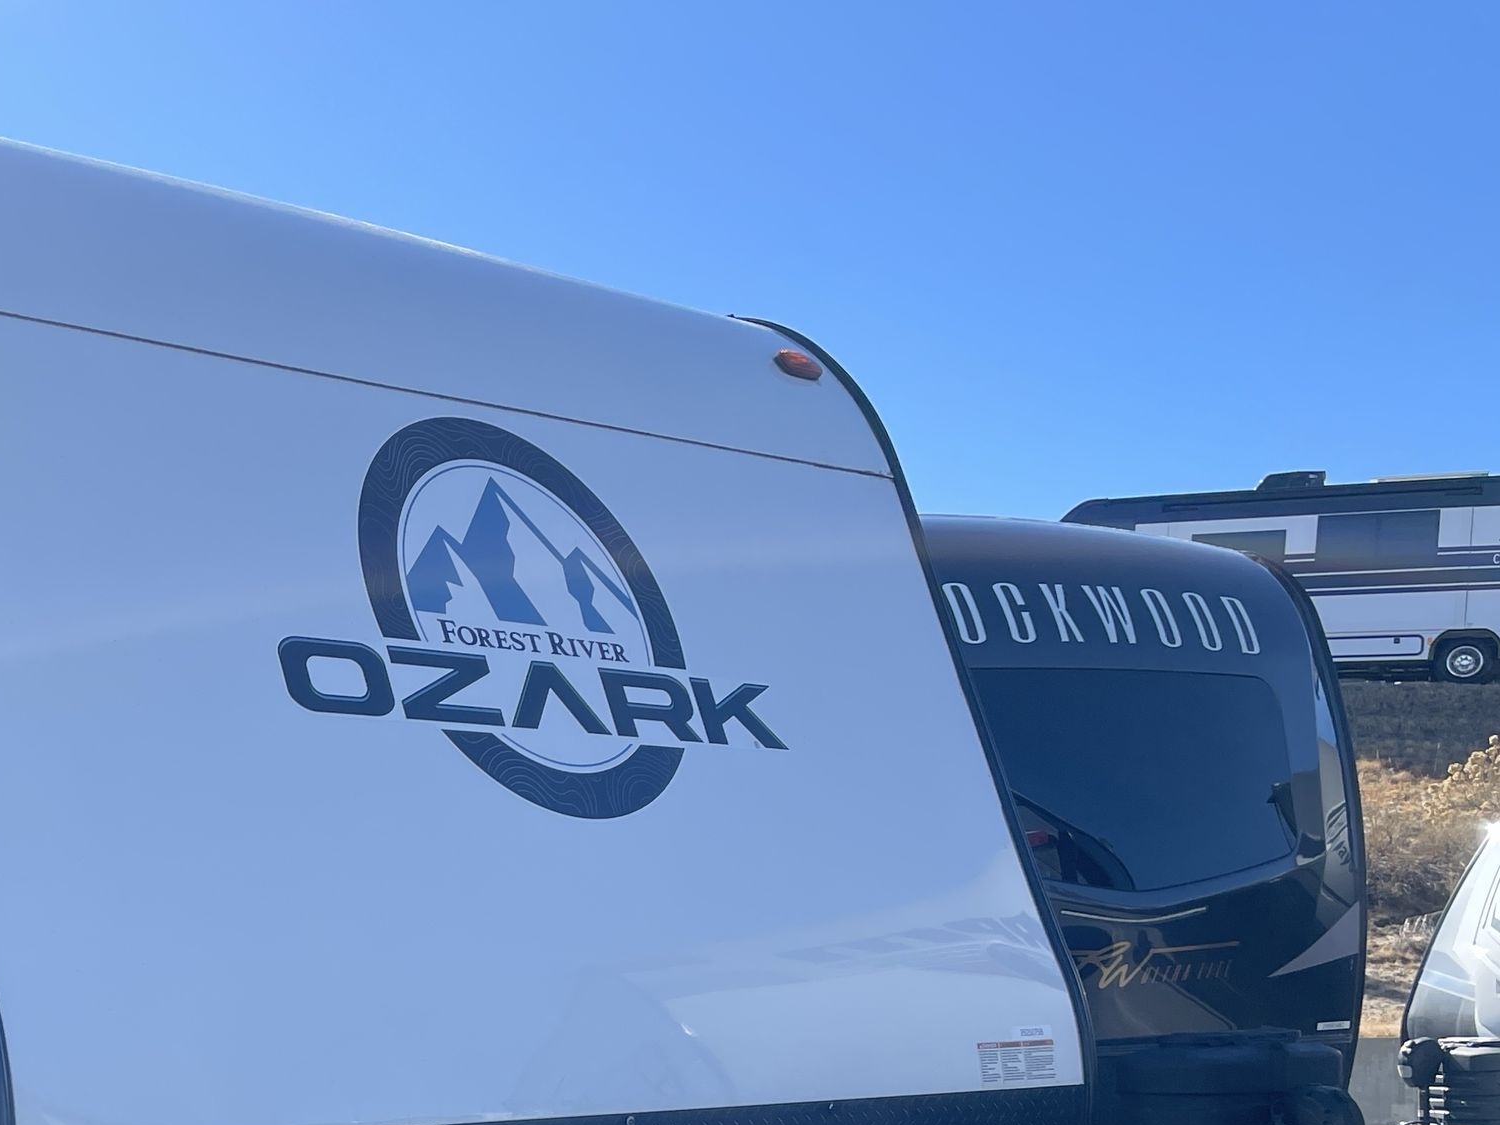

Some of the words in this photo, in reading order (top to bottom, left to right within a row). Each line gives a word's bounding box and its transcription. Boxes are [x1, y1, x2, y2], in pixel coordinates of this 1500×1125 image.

[437, 618, 542, 653] FOREST
[545, 631, 630, 663] RIVER
[941, 582, 1261, 655] OCKWOOD
[277, 635, 790, 750] OZARK
